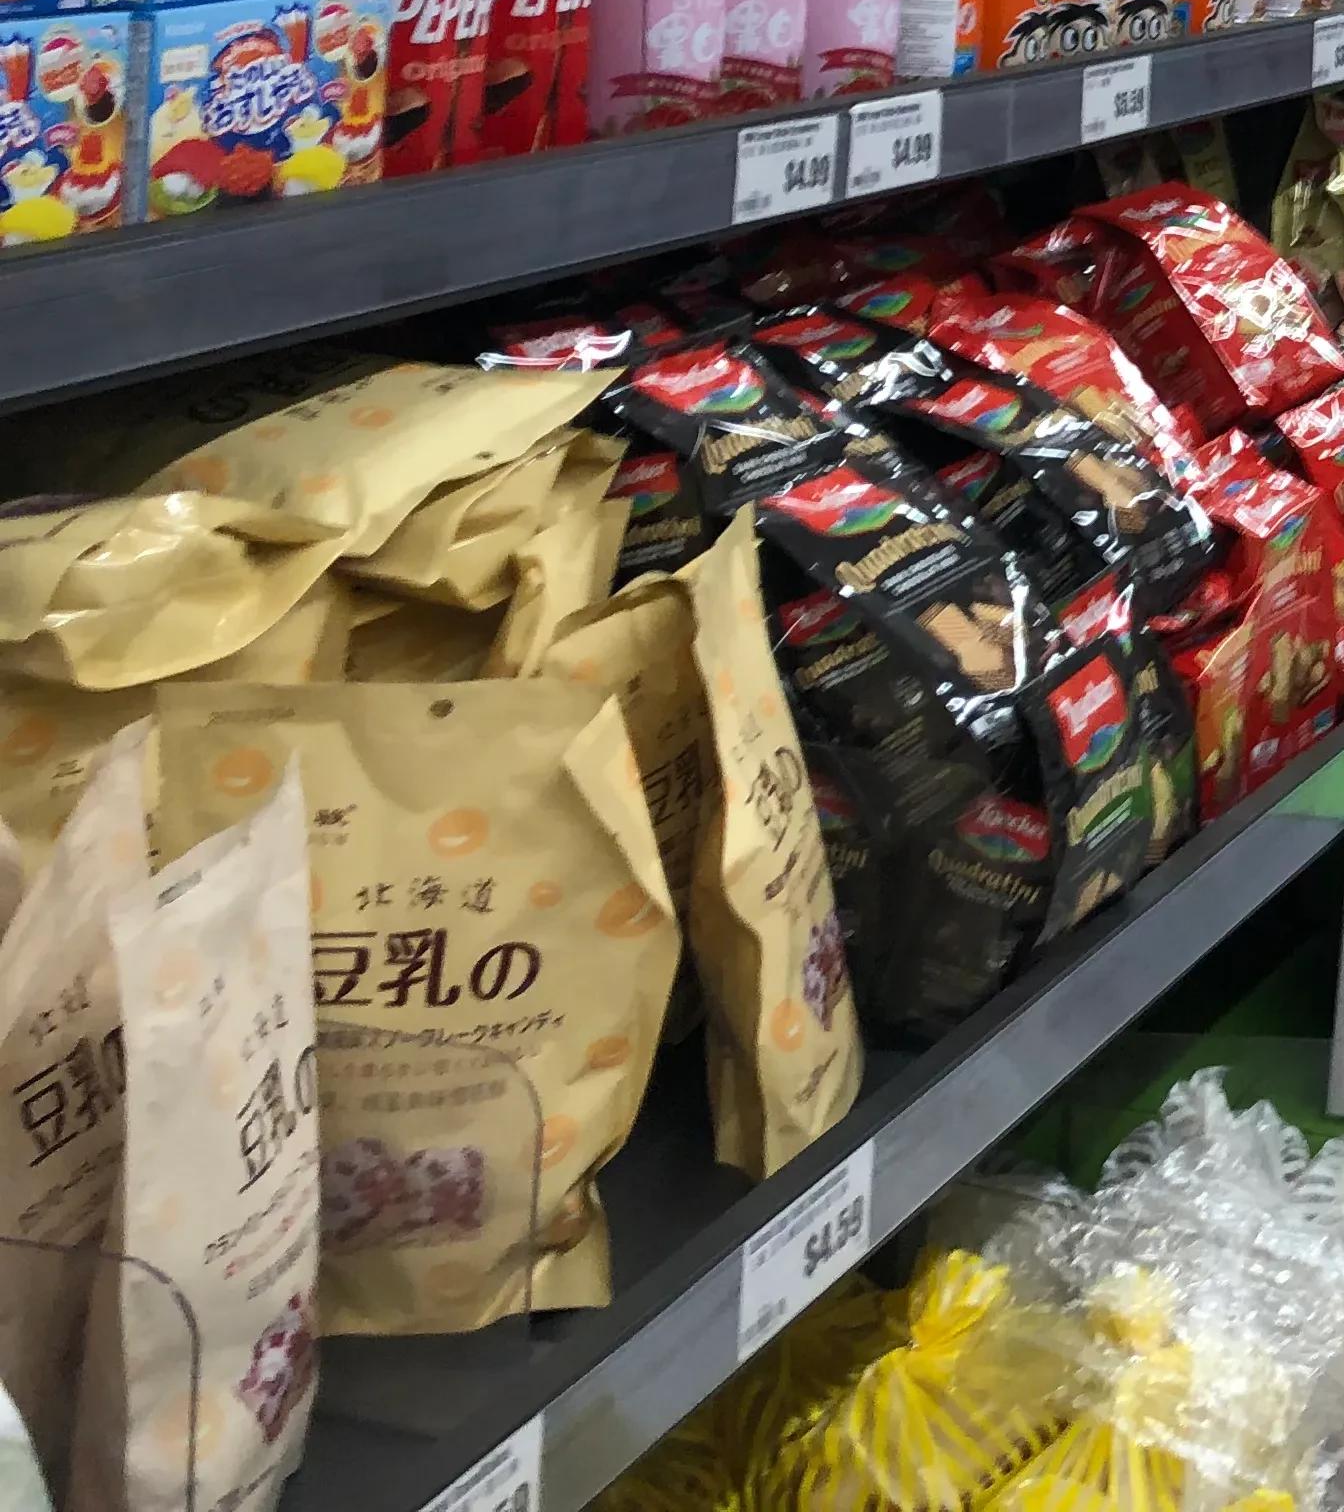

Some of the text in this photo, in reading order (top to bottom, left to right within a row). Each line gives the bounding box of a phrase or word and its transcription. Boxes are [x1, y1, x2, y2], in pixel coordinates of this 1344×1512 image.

[891, 131, 933, 169] $4.99
[782, 153, 832, 193] $4.99
[354, 874, 498, 914] 北海道
[310, 926, 544, 1009] 豆乳の
[803, 1193, 866, 1278] $4.59
